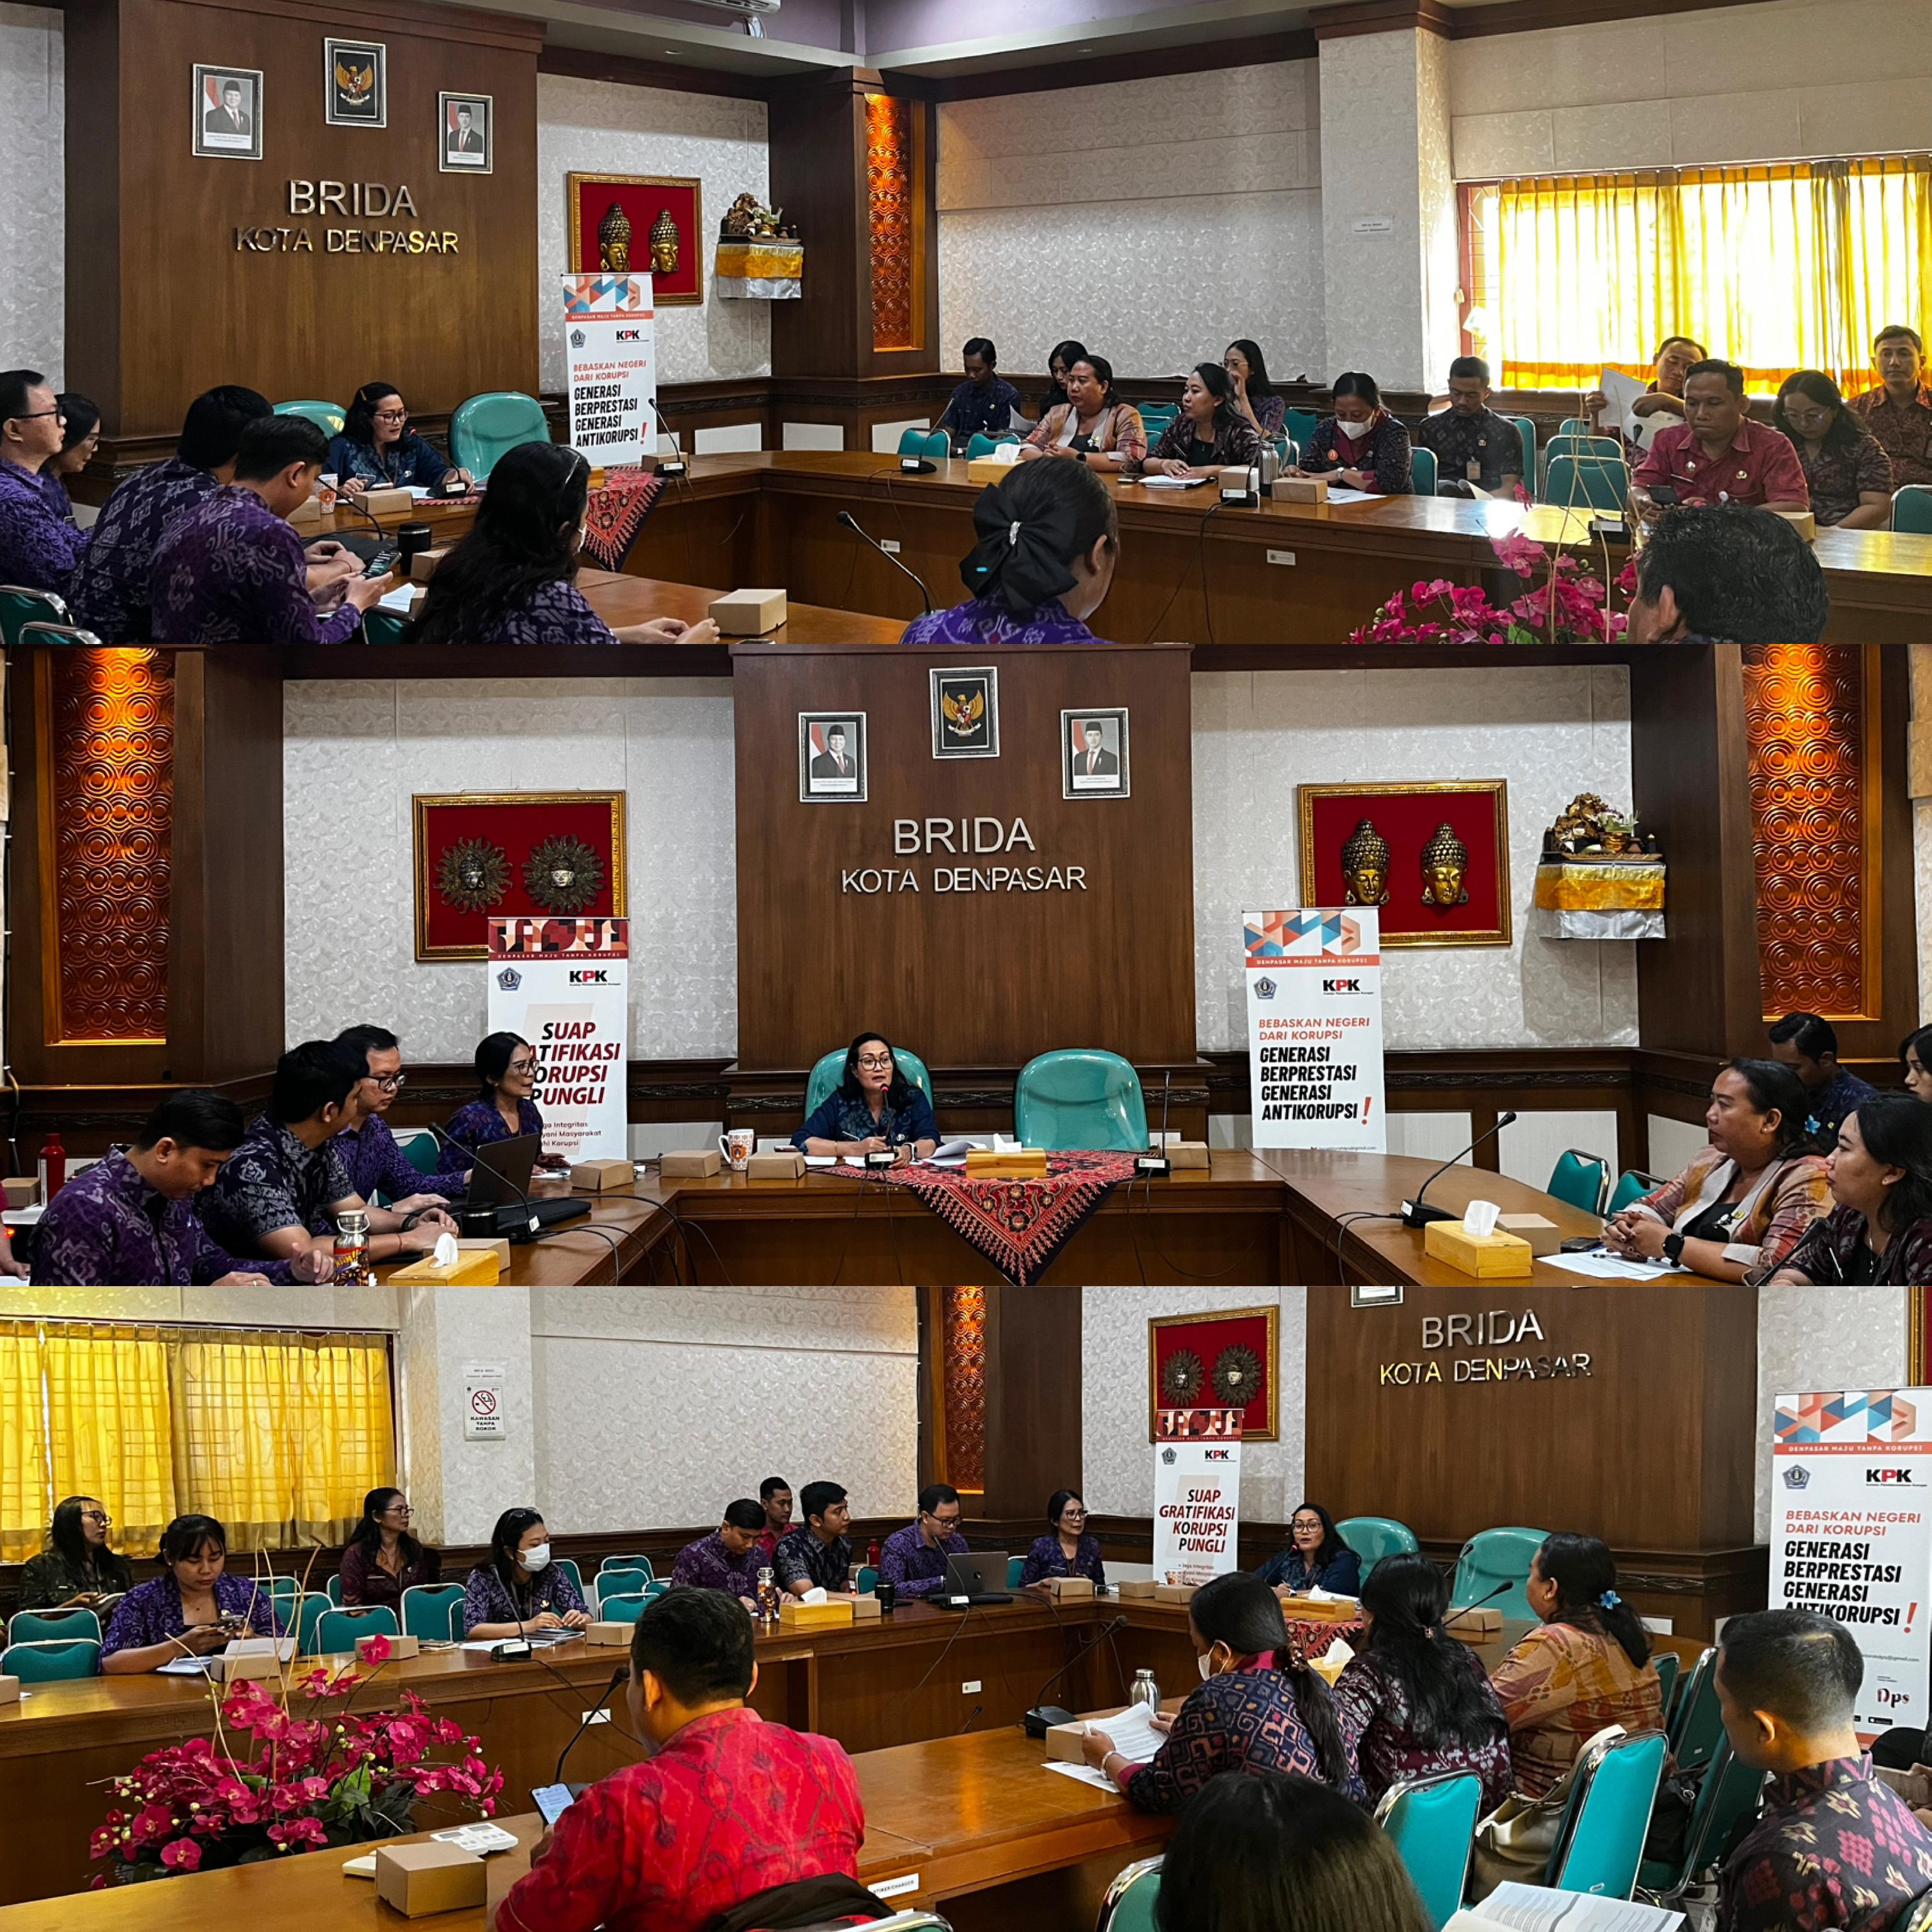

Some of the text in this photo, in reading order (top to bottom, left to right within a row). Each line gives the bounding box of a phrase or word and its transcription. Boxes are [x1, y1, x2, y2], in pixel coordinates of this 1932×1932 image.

[290, 180, 418, 217] BRIDA
[236, 227, 459, 253] KOTA DENPASAR
[616, 330, 640, 340] KPK
[574, 360, 647, 372] BEBASKAN NEGERI
[574, 371, 629, 382] DARI KORUPSI
[574, 384, 621, 401] GENERASI
[575, 398, 638, 416] BERPRESTASI
[575, 415, 621, 432] GENERASI
[575, 428, 638, 448] ANTIKORUPSI
[893, 818, 1036, 855] BRIDA
[841, 866, 1087, 894] KOTA DENPASAR
[569, 970, 608, 982] KPK
[1323, 979, 1360, 992] KPK
[541, 1022, 596, 1040] SUAP
[1258, 1017, 1370, 1028] BEBASKAN NEGERI
[1259, 1030, 1343, 1041] DARI KORUPSI
[530, 1043, 621, 1062] ATIFIKASI
[1260, 1046, 1331, 1063] GENERASI
[535, 1065, 608, 1084] ORUPSI
[1260, 1064, 1357, 1082] BERPRESTASI
[531, 1087, 605, 1106] PUNGLI
[1262, 1084, 1332, 1102] GENERASI
[1262, 1102, 1358, 1121] ANTIKORUPSI
[1421, 1308, 1545, 1349] BRIDA
[1380, 1353, 1592, 1385] KOTA DENPASAR
[1205, 1450, 1229, 1459] KPK
[1866, 1468, 1912, 1483] KPK
[1187, 1489, 1221, 1502] SUAP
[1159, 1505, 1235, 1520] GRATIFIKASI
[1785, 1510, 1921, 1524] BEBASKAN NEGERI
[1172, 1521, 1228, 1537] KORUPSI
[1785, 1523, 1887, 1536] DARI KORUPSI
[1179, 1538, 1226, 1553] PUNGLI
[1785, 1541, 1870, 1560] GENERASI
[1784, 1561, 1902, 1583] BERPRESTASI
[1784, 1581, 1868, 1602] GENERASI
